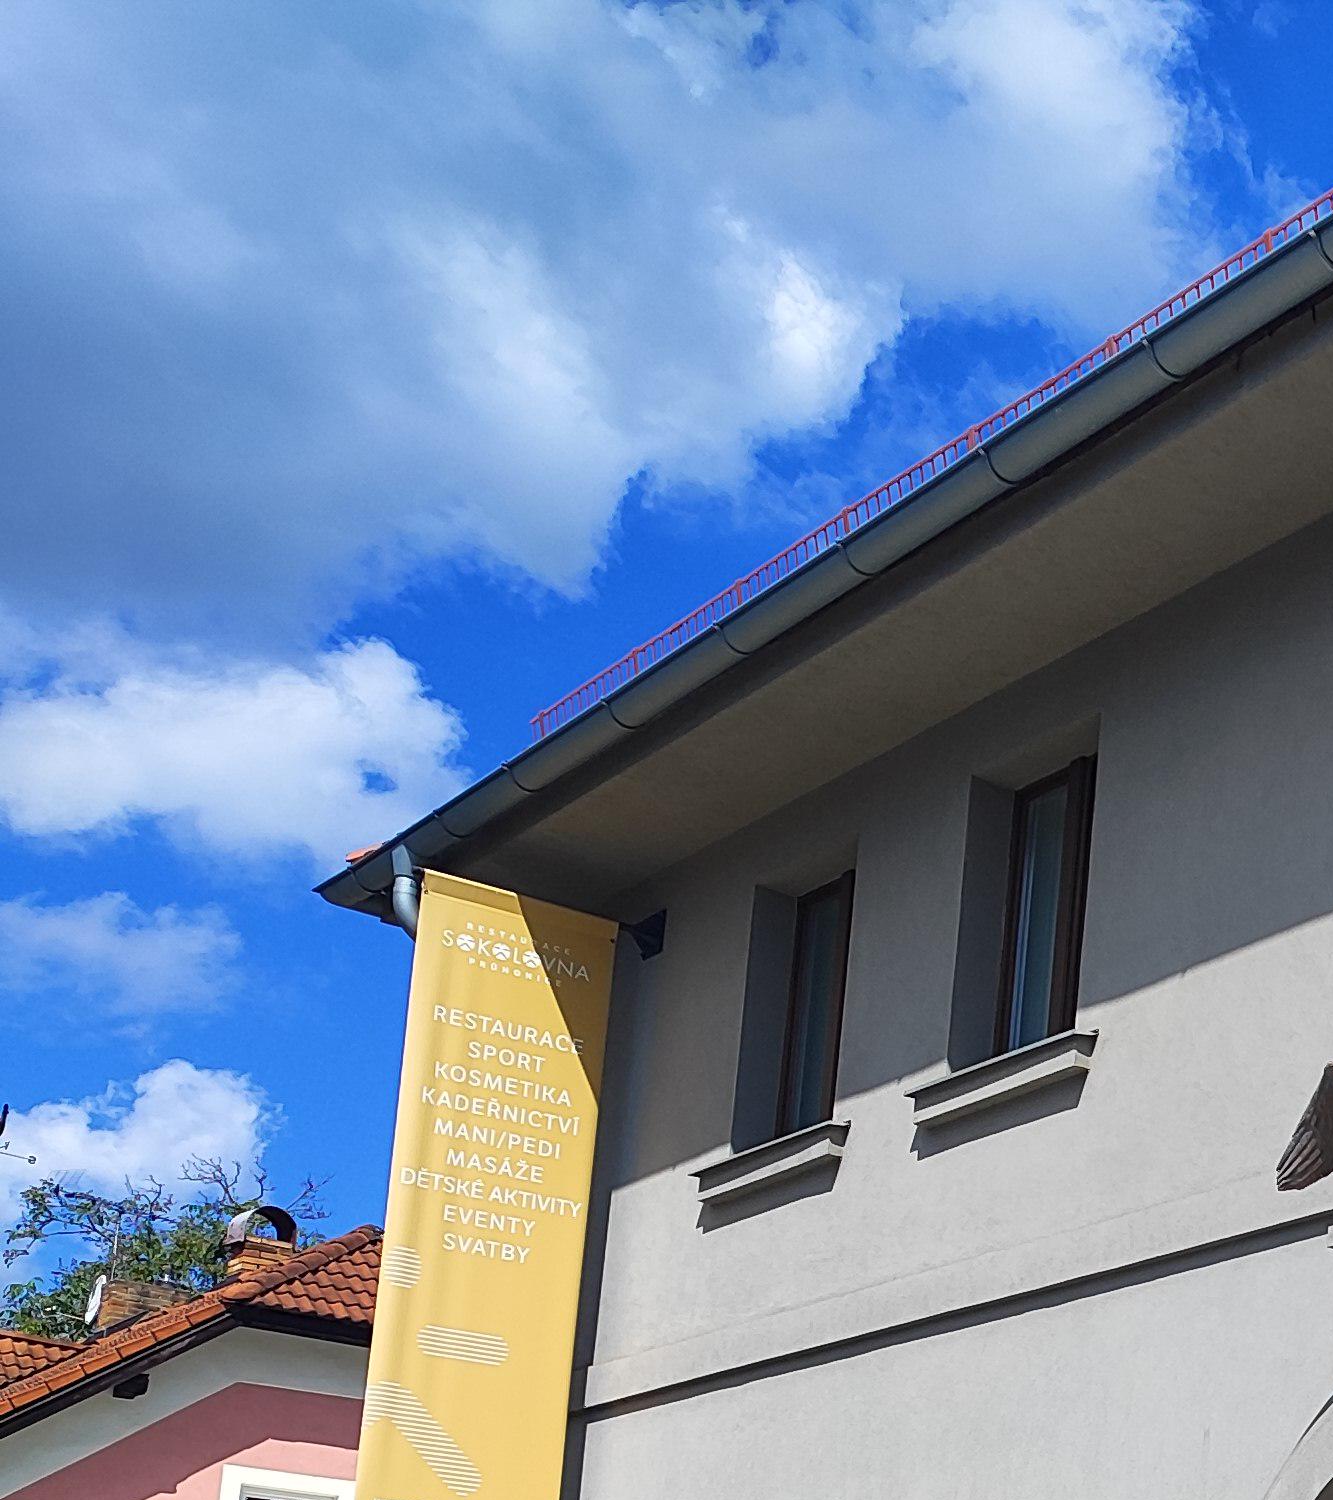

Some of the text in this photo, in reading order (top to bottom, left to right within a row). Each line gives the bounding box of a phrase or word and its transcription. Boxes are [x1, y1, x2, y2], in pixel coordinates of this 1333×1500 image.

[433, 1004, 584, 1057] RESTAURACE
[467, 1041, 546, 1073] SPORT
[434, 1061, 573, 1107] KOSMETIKA
[421, 1086, 580, 1136] KADEŘNICTVÍ
[433, 1118, 562, 1160] MANI/PEDI
[446, 1148, 544, 1184] MASÁŽE
[400, 1167, 582, 1218] DĚTSKÉ AKTIVITY
[443, 1205, 535, 1237] EVENTY
[442, 1233, 530, 1264] SVATBY
